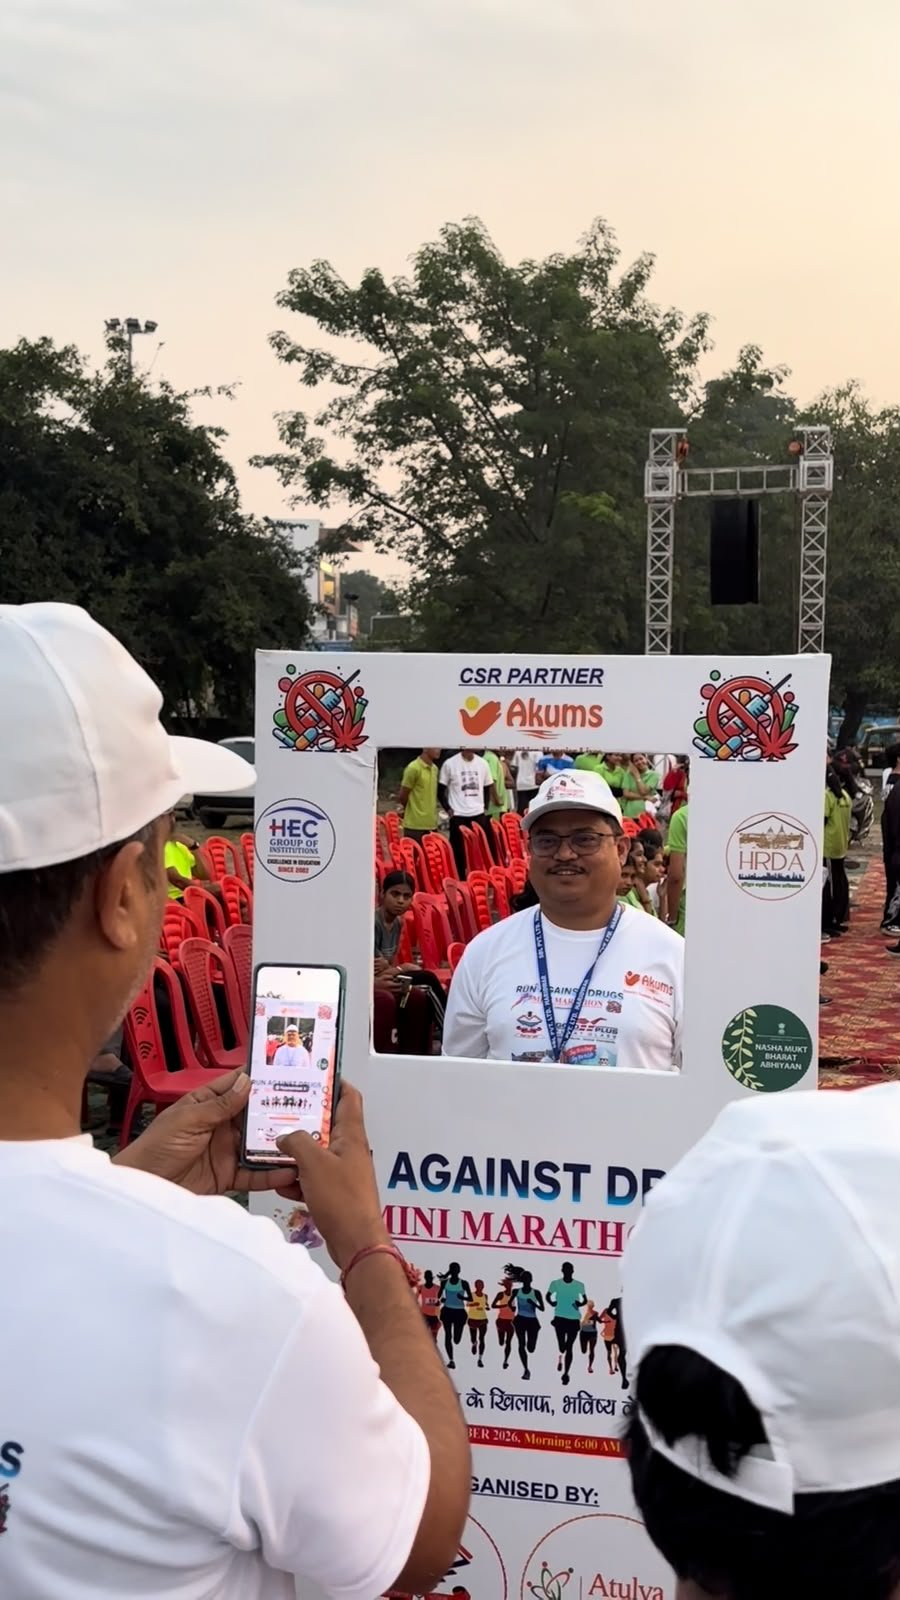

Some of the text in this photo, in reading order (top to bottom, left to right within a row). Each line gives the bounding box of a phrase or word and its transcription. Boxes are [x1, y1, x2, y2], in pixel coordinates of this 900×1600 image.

[459, 667, 604, 685] CSR PARTNER
[506, 697, 604, 728] Akums
[268, 818, 319, 838] HEC
[269, 838, 319, 848] GROUP OF
[269, 846, 319, 855] INSTITUTIONS
[739, 850, 805, 871] HRDA
[516, 985, 538, 993] RUN
[588, 989, 624, 1000] DRUGS
[642, 974, 674, 996] Akums
[595, 1026, 619, 1035] PLUS
[755, 1043, 808, 1053] NASHA MUKT
[764, 1052, 798, 1061] BHARAT
[760, 1061, 802, 1070] ABHIYAAN
[387, 1151, 591, 1203] AGAINST
[461, 1210, 638, 1252] MARATH
[466, 1387, 485, 1409] के
[563, 1390, 617, 1416] भविष्य
[524, 1433, 572, 1450] Morning
[574, 1437, 598, 1450] 6:00
[599, 1440, 620, 1452] AM
[565, 1485, 599, 1504] BY:
[588, 1573, 664, 1600] Atulya
